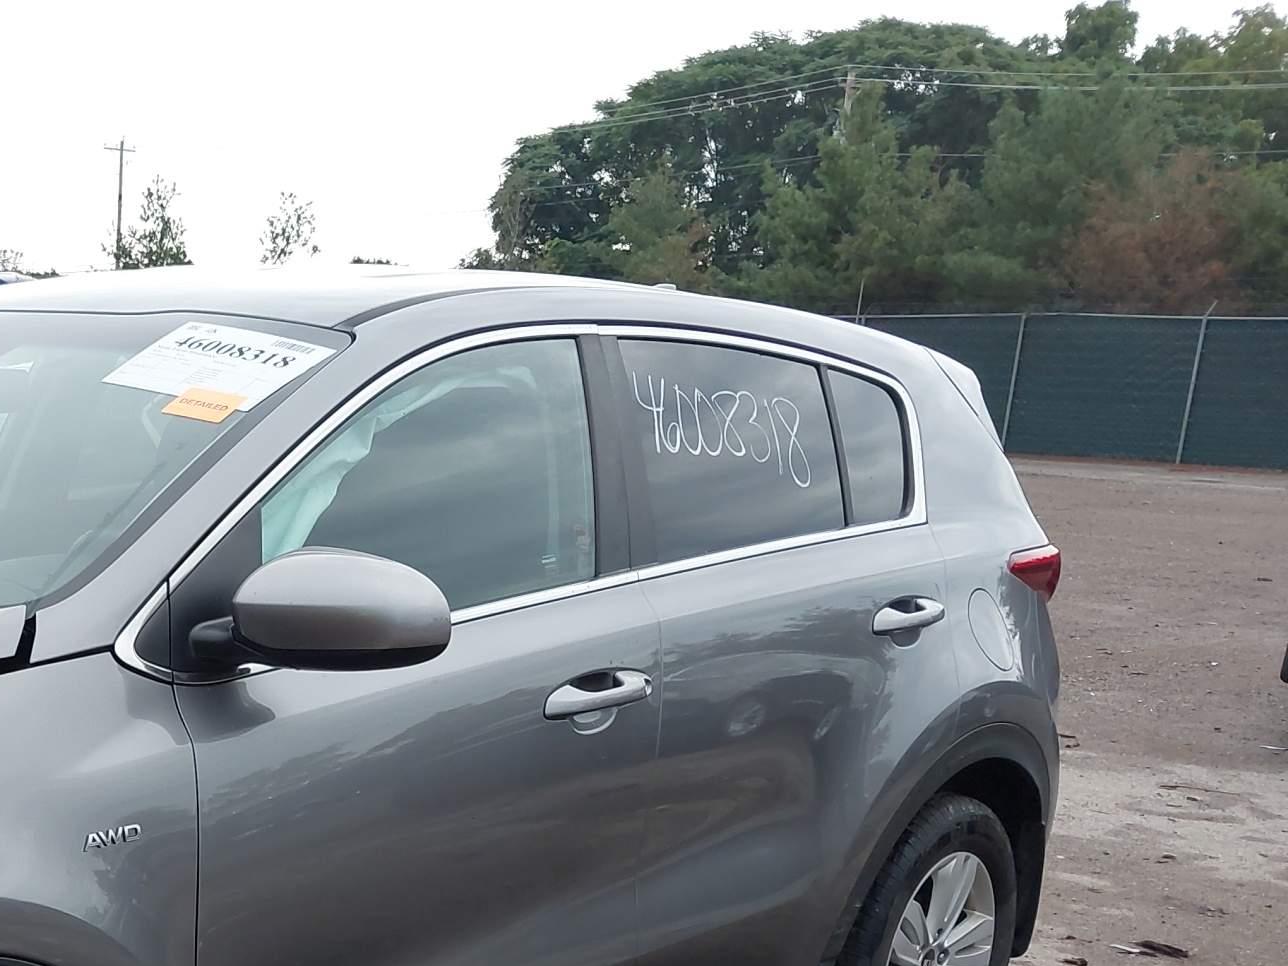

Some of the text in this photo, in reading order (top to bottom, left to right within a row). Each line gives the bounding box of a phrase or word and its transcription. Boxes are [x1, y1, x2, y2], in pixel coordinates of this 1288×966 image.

[175, 335, 297, 368] 46008318
[178, 398, 230, 412] DETAILED
[632, 370, 811, 488] 46008318
[81, 823, 142, 853] AWD
